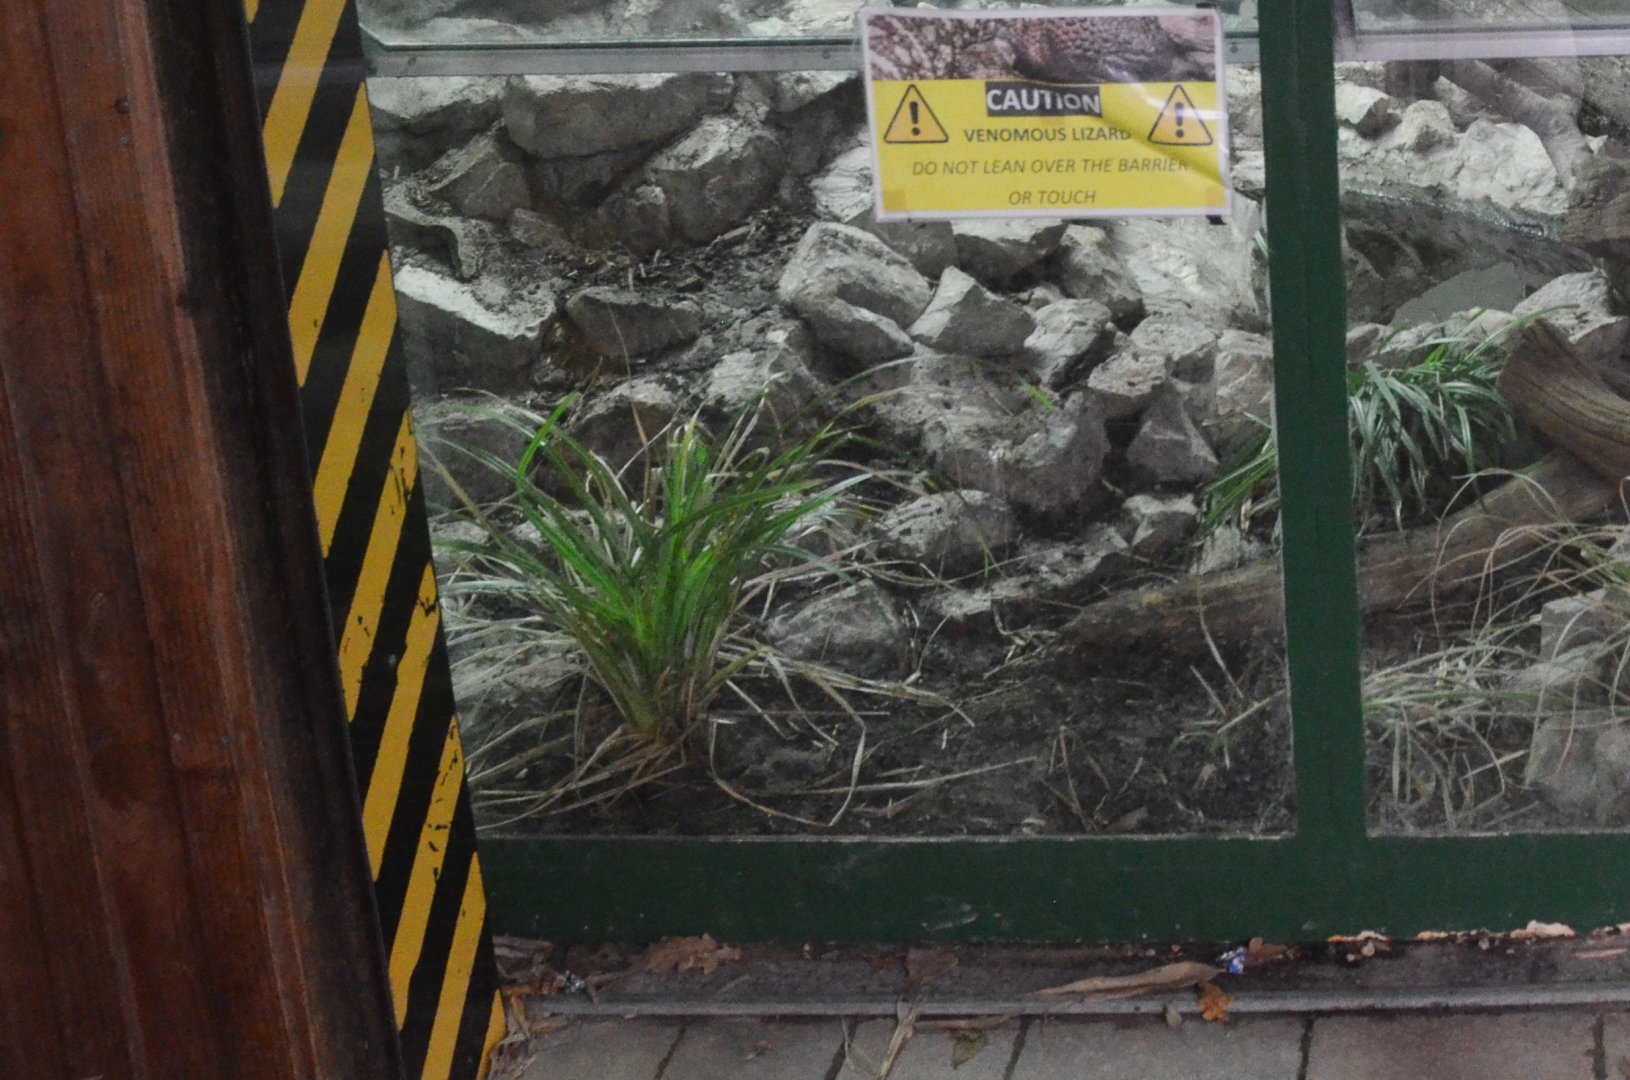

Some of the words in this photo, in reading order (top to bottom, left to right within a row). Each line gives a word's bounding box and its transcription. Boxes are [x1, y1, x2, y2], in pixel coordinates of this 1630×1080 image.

[987, 88, 1101, 114] CAUTION
[964, 127, 1067, 142] VENOMOUS
[1072, 126, 1131, 141] LIZARD
[913, 161, 938, 175] DO
[943, 160, 977, 174] NOT
[984, 160, 1025, 174] LEAN
[1031, 159, 1077, 173] OVER
[1082, 158, 1112, 172] THE
[1118, 157, 1188, 172] BARRIER
[1009, 191, 1034, 205] OR
[1039, 190, 1096, 205] TOUCH
